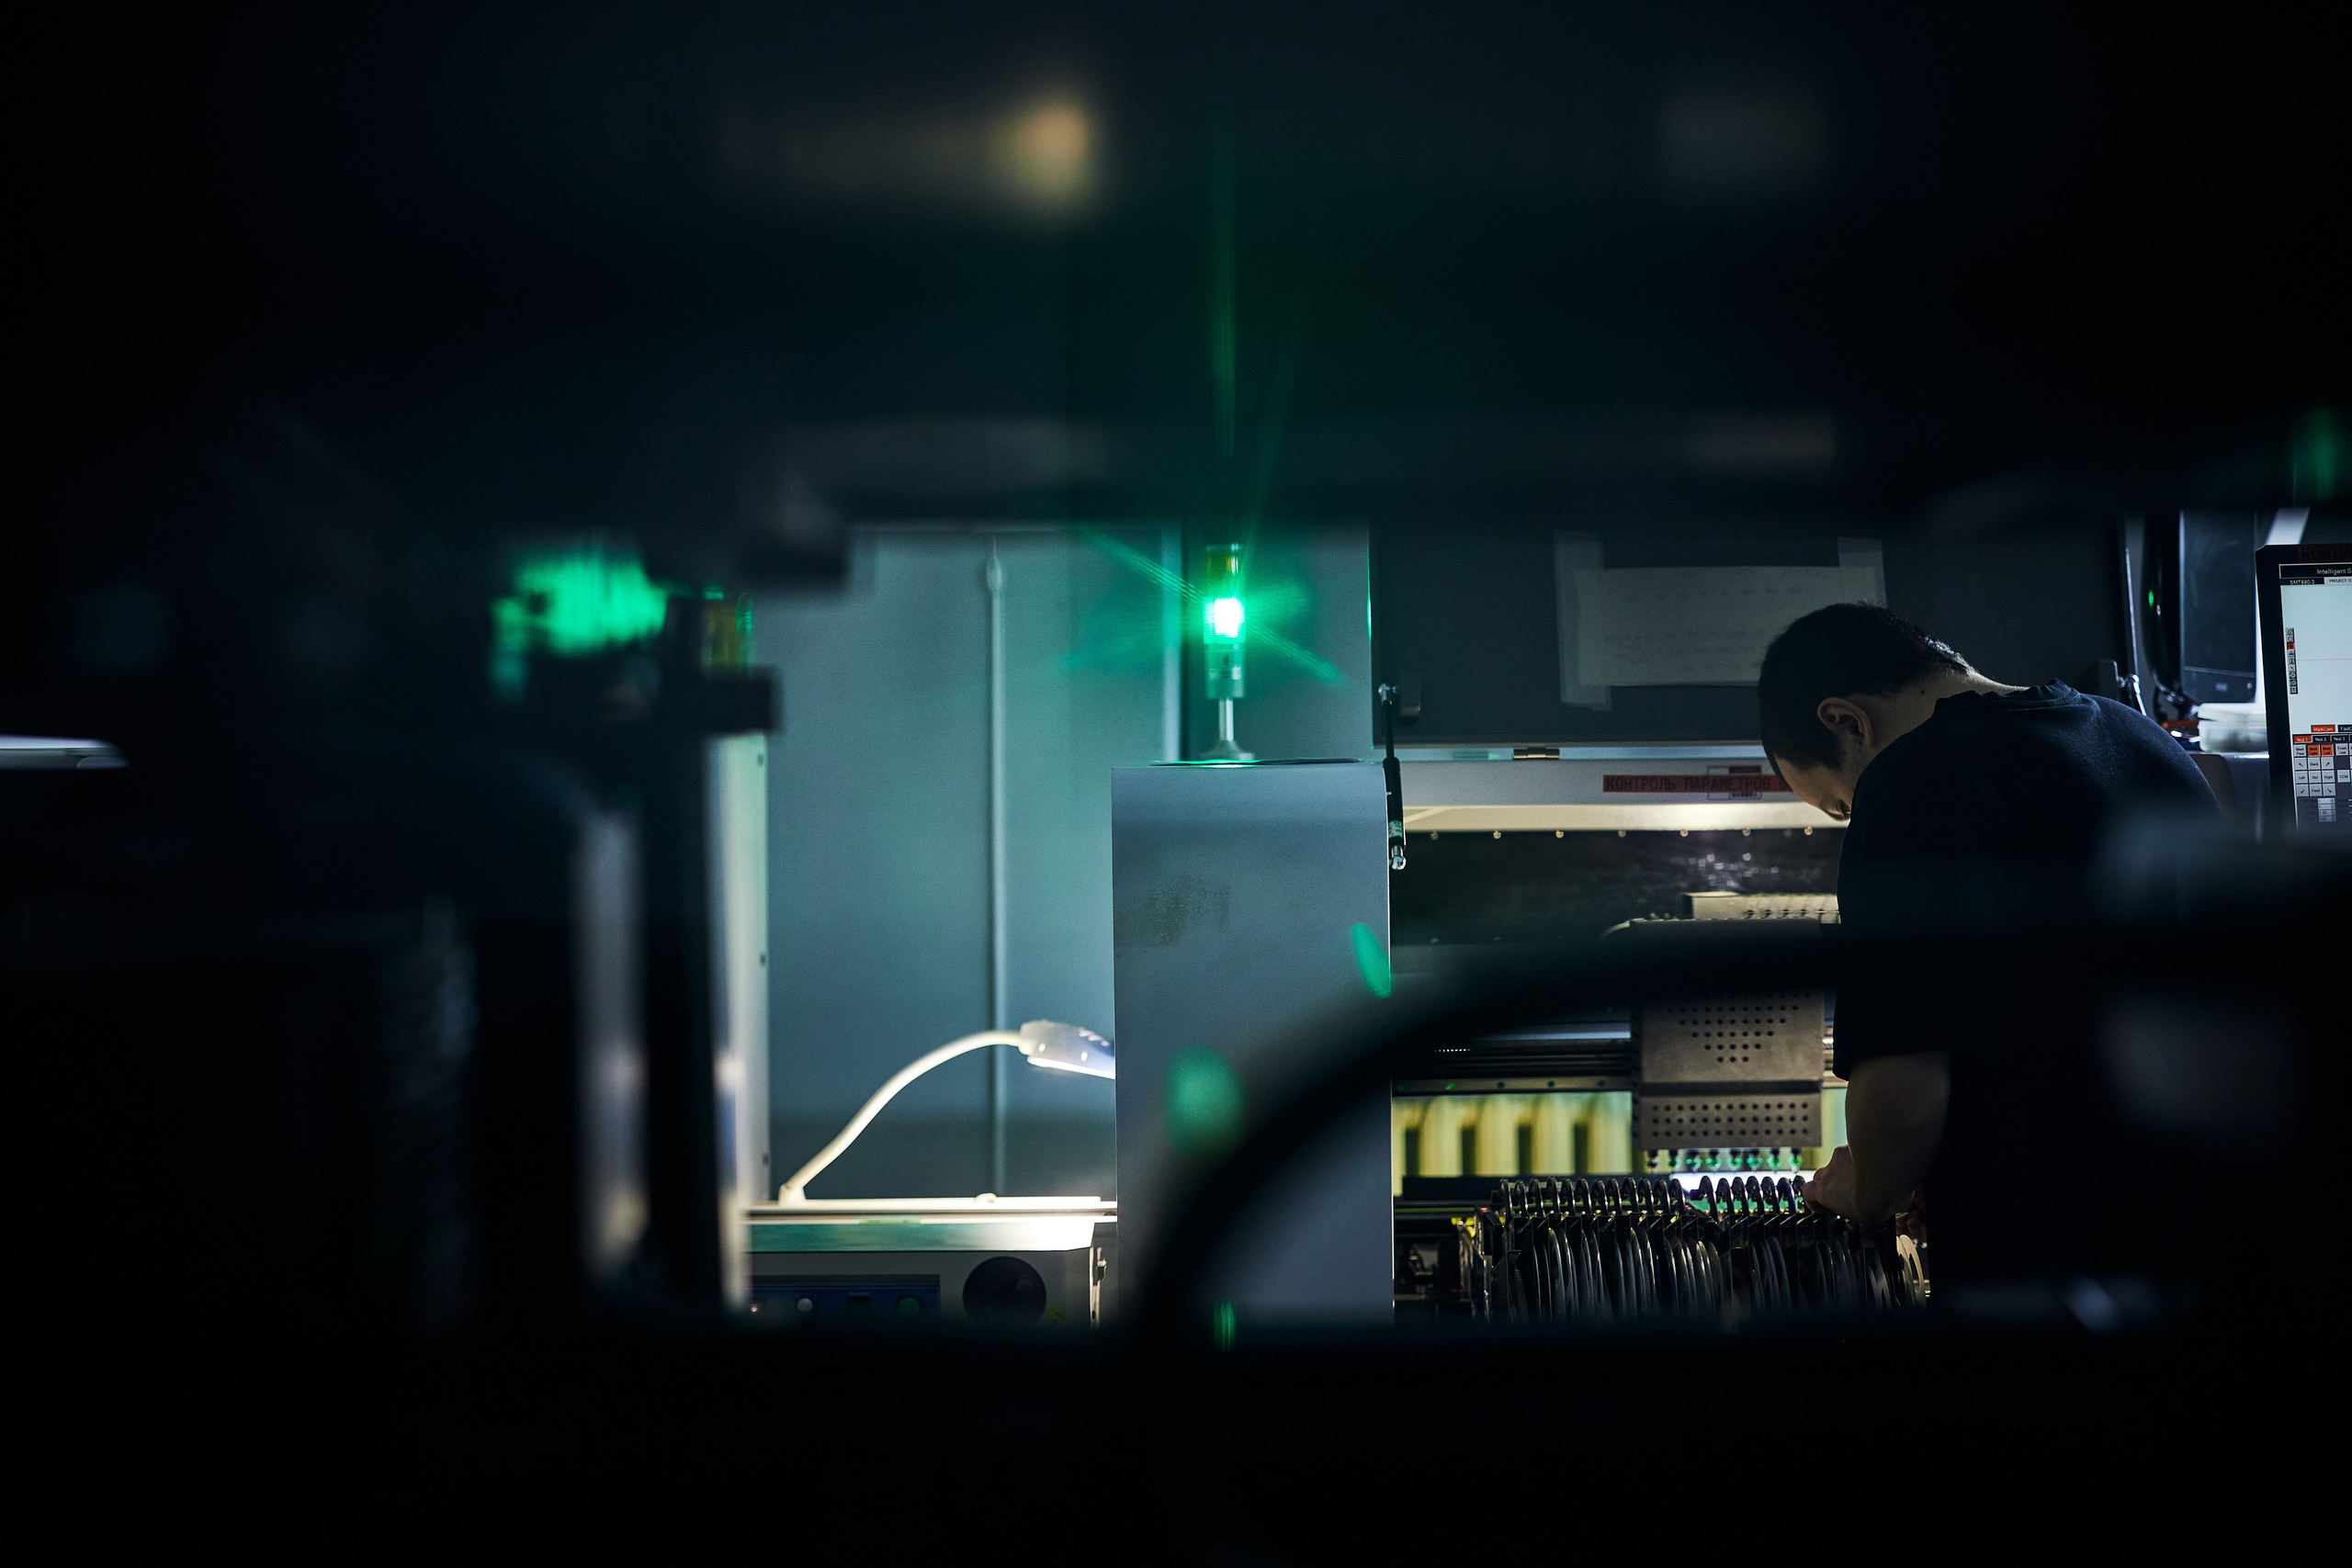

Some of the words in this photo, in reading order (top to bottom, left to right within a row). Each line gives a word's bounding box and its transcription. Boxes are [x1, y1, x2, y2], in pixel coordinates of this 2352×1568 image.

[2316, 568, 2346, 576] Intelligent
[1605, 776, 1676, 791] КОНТРОЛЬ
[1684, 776, 1771, 792] ПАРАМЕТРОВ
